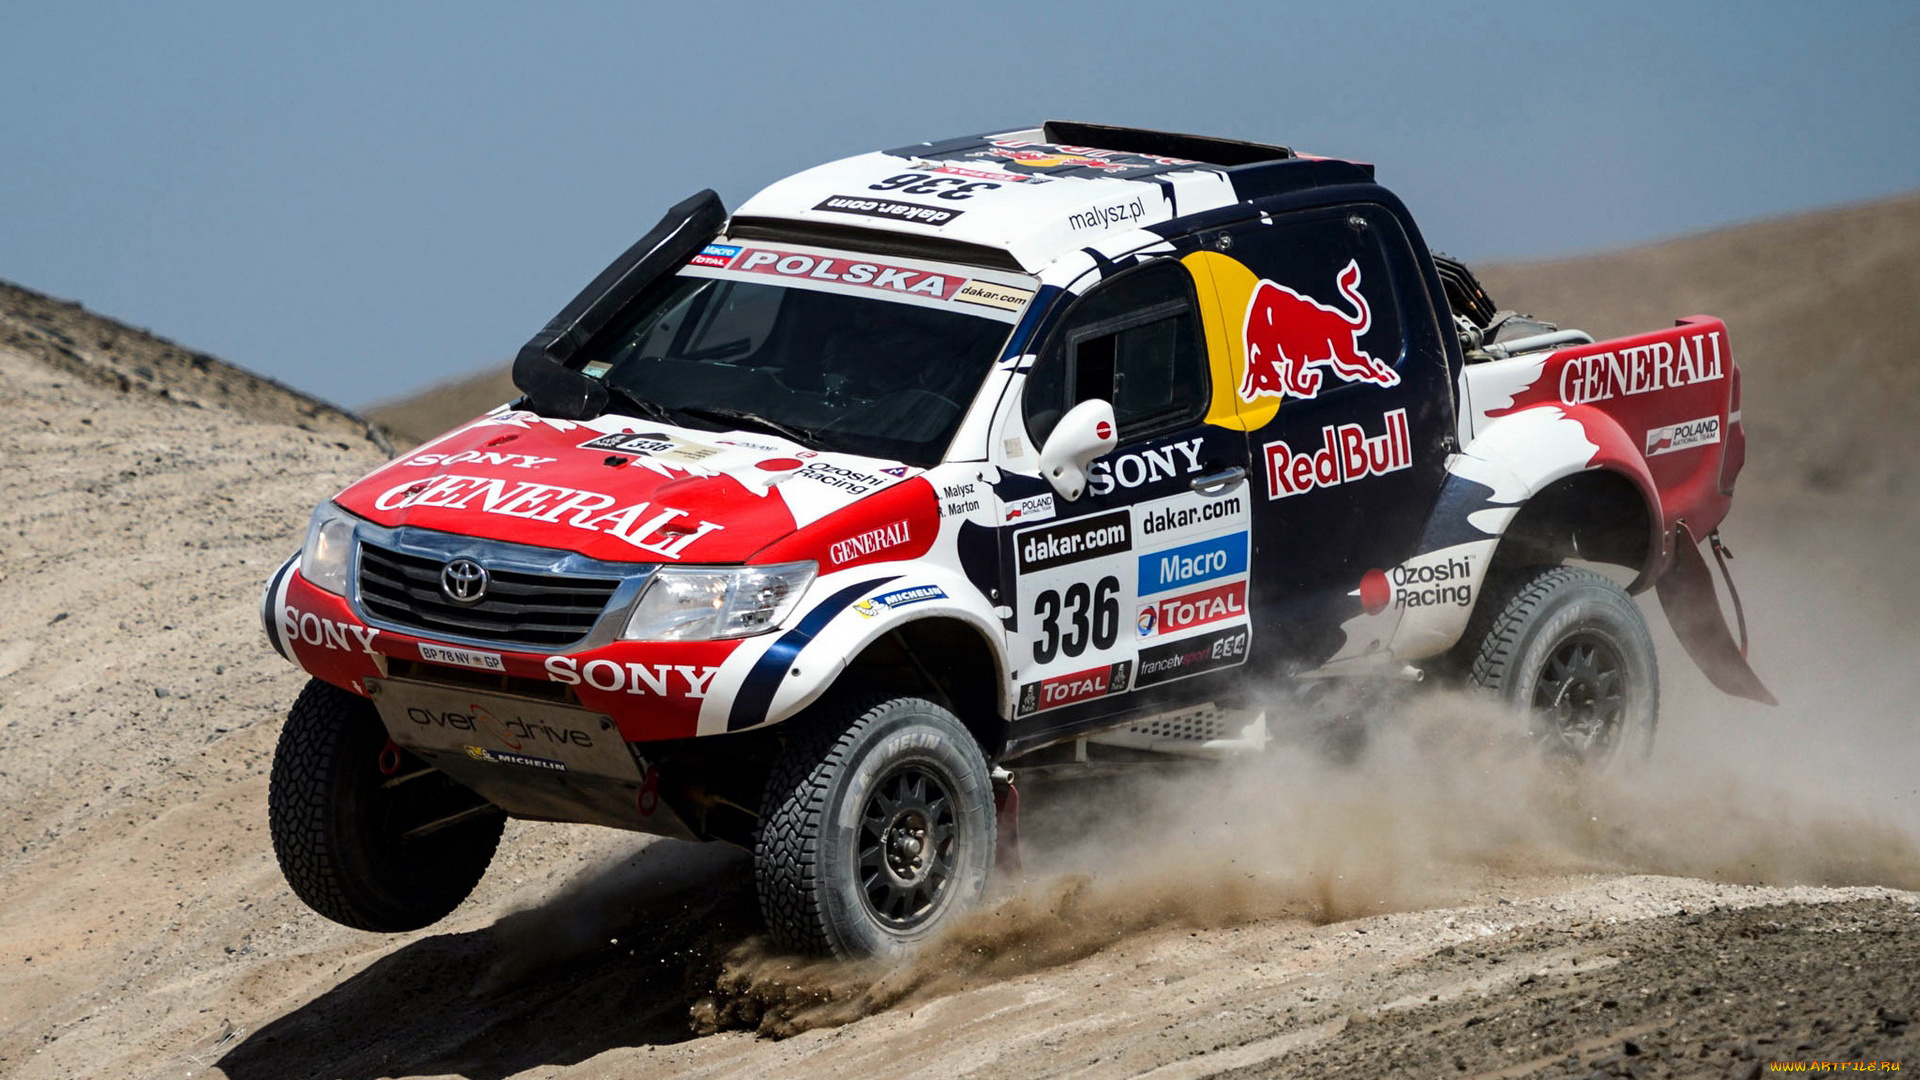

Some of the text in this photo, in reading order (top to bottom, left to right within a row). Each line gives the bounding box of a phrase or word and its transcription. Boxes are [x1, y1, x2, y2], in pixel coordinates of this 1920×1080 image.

[868, 174, 1001, 200] 336
[827, 199, 950, 222] dakar.com
[1068, 197, 1146, 231] malysz.pl
[691, 255, 726, 266] TOTAL
[741, 250, 946, 296] POLSKA
[960, 285, 1027, 306] dakar.com
[1559, 331, 1724, 407] GENERALI
[1672, 431, 1715, 447] NATIONAL TEAM
[1673, 420, 1718, 440] POLAND
[627, 440, 675, 452] 336
[404, 450, 557, 469] SONY
[1087, 437, 1205, 498] SONY
[792, 469, 869, 495] Racing
[808, 463, 888, 486] Ozoshi
[943, 484, 976, 499] Malysz
[1022, 496, 1052, 511] POLAND
[375, 474, 725, 560] GENERALI
[948, 500, 980, 516] Marton
[1143, 497, 1241, 535] dakar.com
[830, 519, 911, 566] GENERALI
[1024, 523, 1126, 564] dakar.com
[1160, 549, 1227, 584] Macro
[1393, 556, 1470, 586] Ozoshi
[884, 588, 943, 605] MICHELIN
[1395, 583, 1471, 610] Racing
[1033, 575, 1120, 665] 336
[1162, 593, 1243, 628] TOTAL
[285, 605, 380, 655] SONY
[423, 647, 438, 660] BP
[484, 656, 500, 668] GP
[544, 655, 721, 698] SONY
[1043, 677, 1106, 702] TOTAL
[407, 707, 593, 748] over drive
[498, 754, 565, 771] MICHELIN
